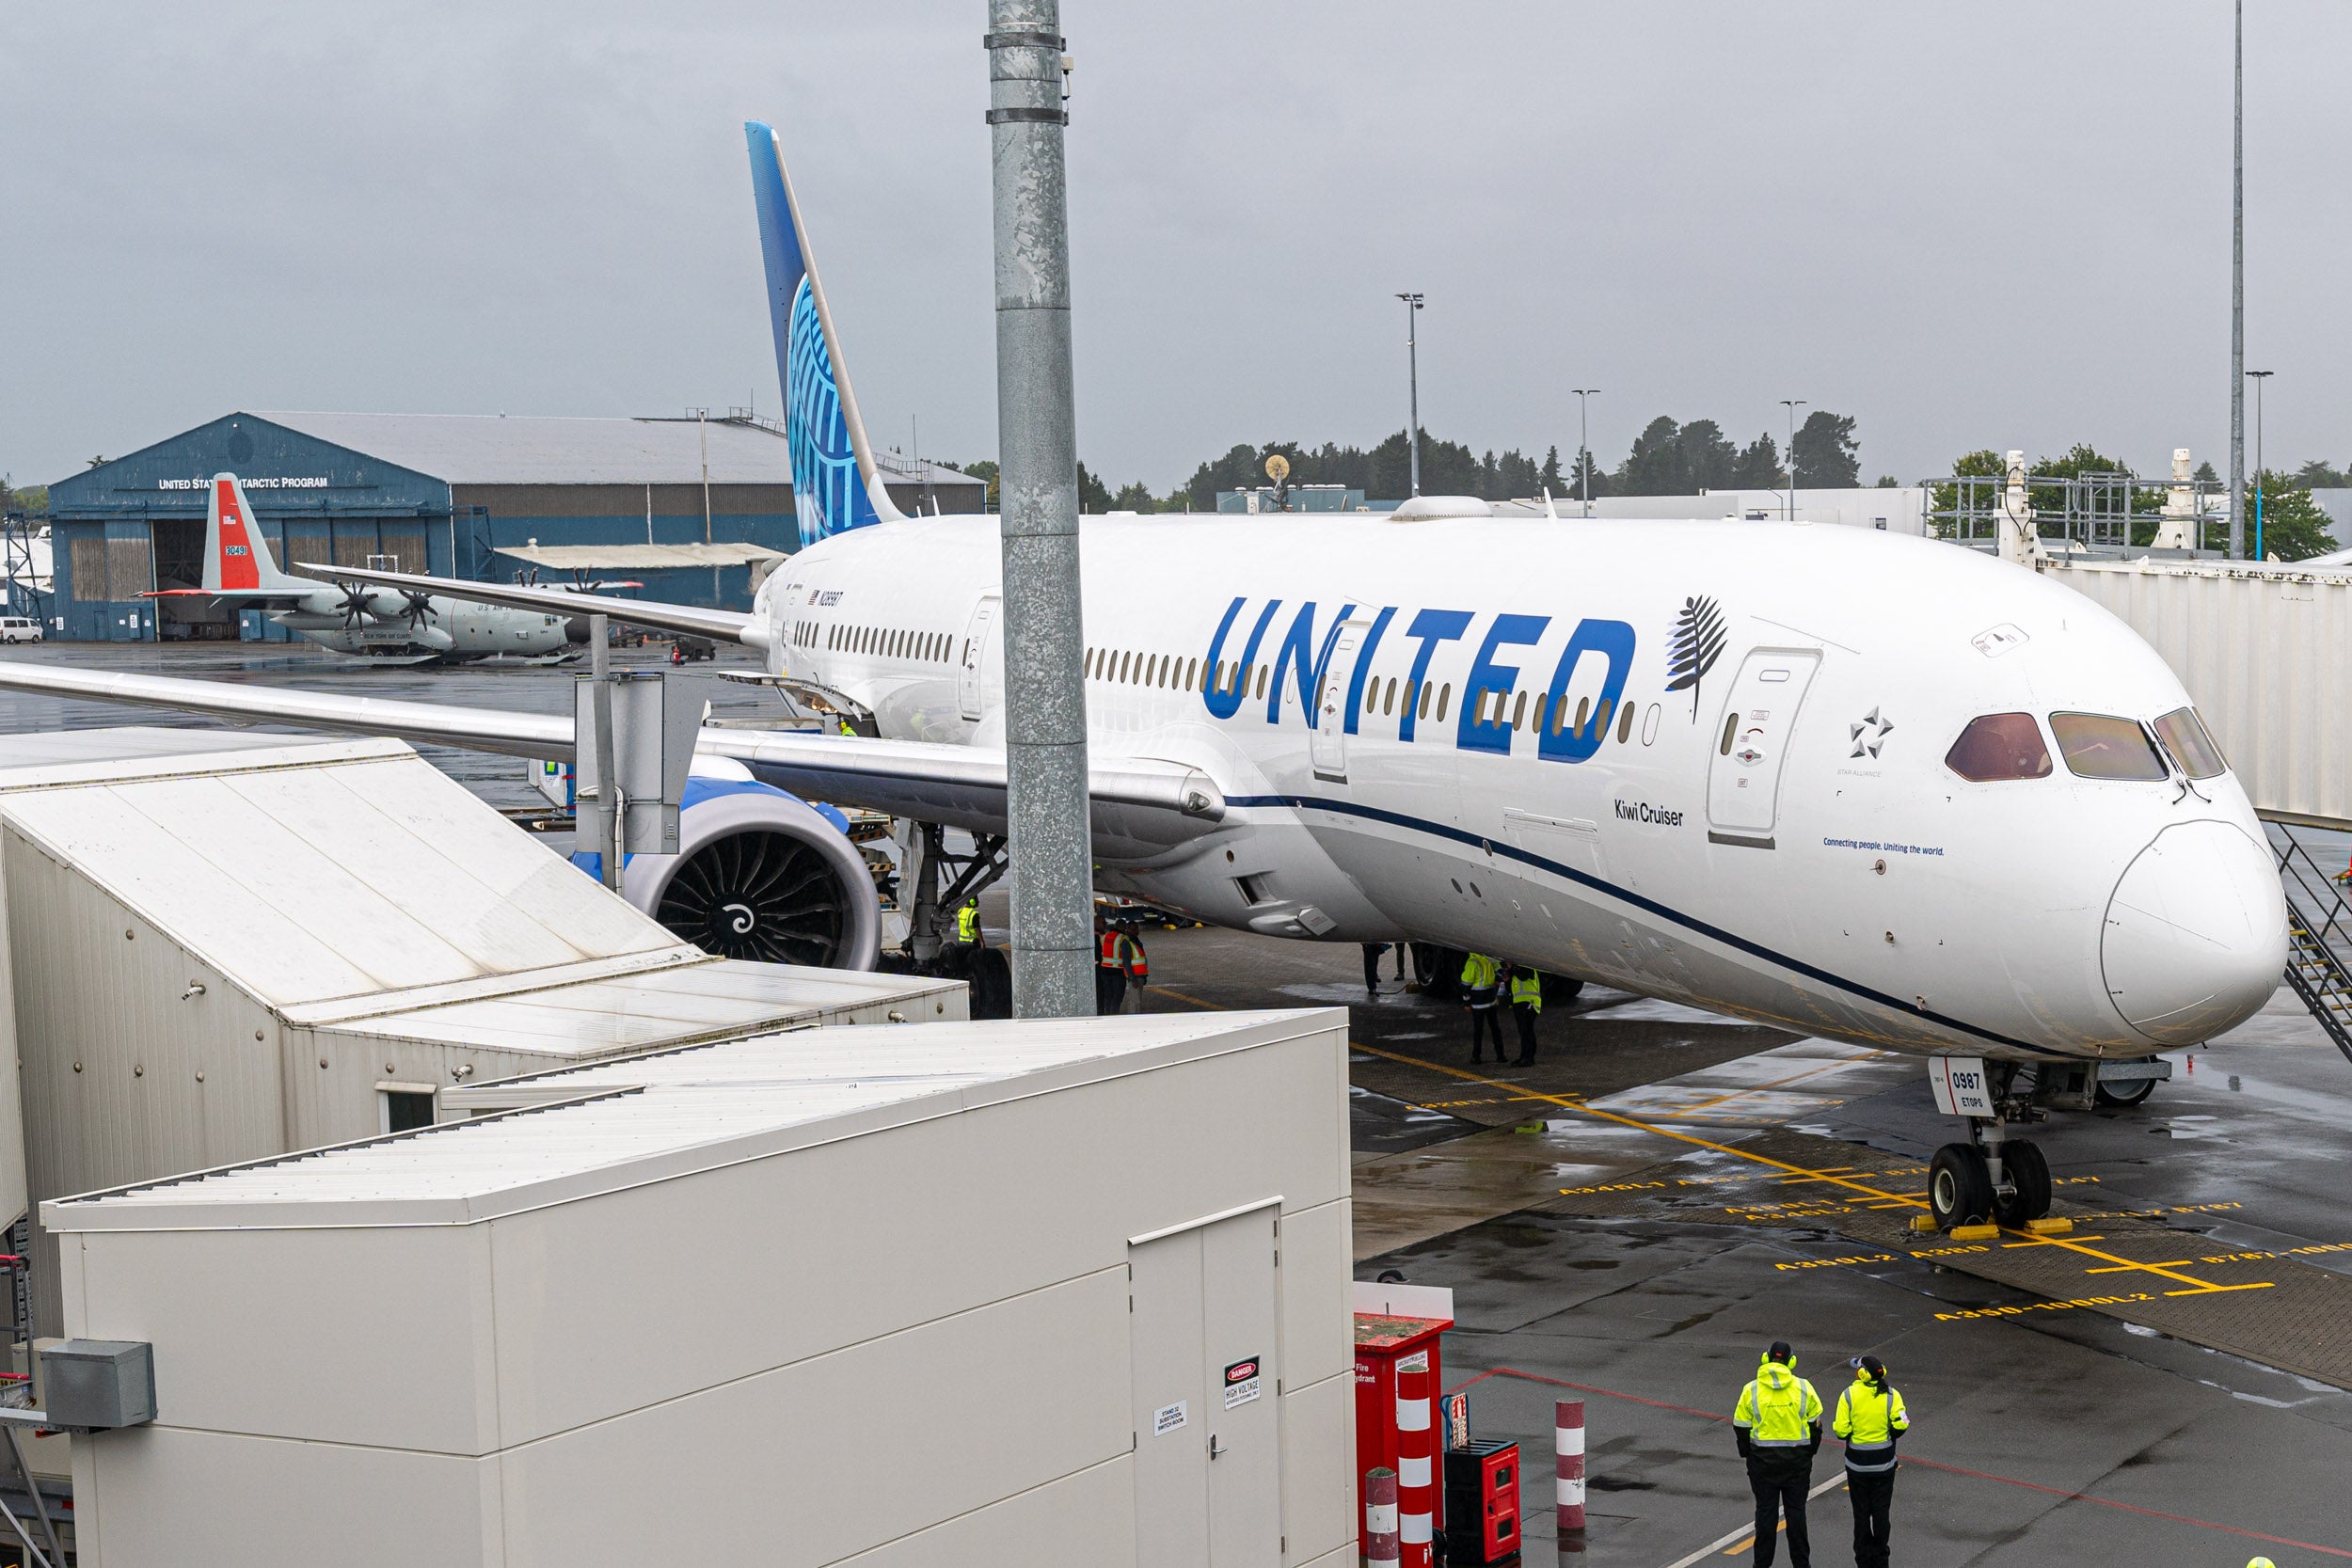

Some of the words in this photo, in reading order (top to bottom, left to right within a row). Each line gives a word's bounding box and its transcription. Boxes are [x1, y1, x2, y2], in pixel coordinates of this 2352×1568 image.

[159, 479, 191, 490] UNITED
[281, 477, 327, 488] PROGRAM
[226, 546, 246, 555] 30491
[1202, 596, 1636, 764] UNITED
[1614, 799, 1639, 821] Kiwi
[1640, 802, 1683, 827] Cruiser
[1823, 837, 1858, 849] Connecting
[1858, 841, 1883, 851] people.
[1883, 843, 1908, 854] Uniting
[1909, 845, 1921, 854] the
[1922, 847, 1945, 856] world.
[1952, 1071, 1979, 1089] 0987
[1962, 1097, 1983, 1108] ETOPS
[2171, 1201, 2243, 1213] B787
[1774, 1254, 1899, 1271] A350L2
[1910, 1244, 1990, 1259] A380
[1934, 1292, 2156, 1322] A350-1000L2
[1231, 1365, 1252, 1379] DANGER
[1356, 1362, 1369, 1372] Fire
[1355, 1374, 1375, 1384] ydrant
[1226, 1388, 1238, 1400] HIGH
[1238, 1380, 1259, 1395] VOLTAGE
[1159, 1412, 1182, 1424] SUBSTATION
